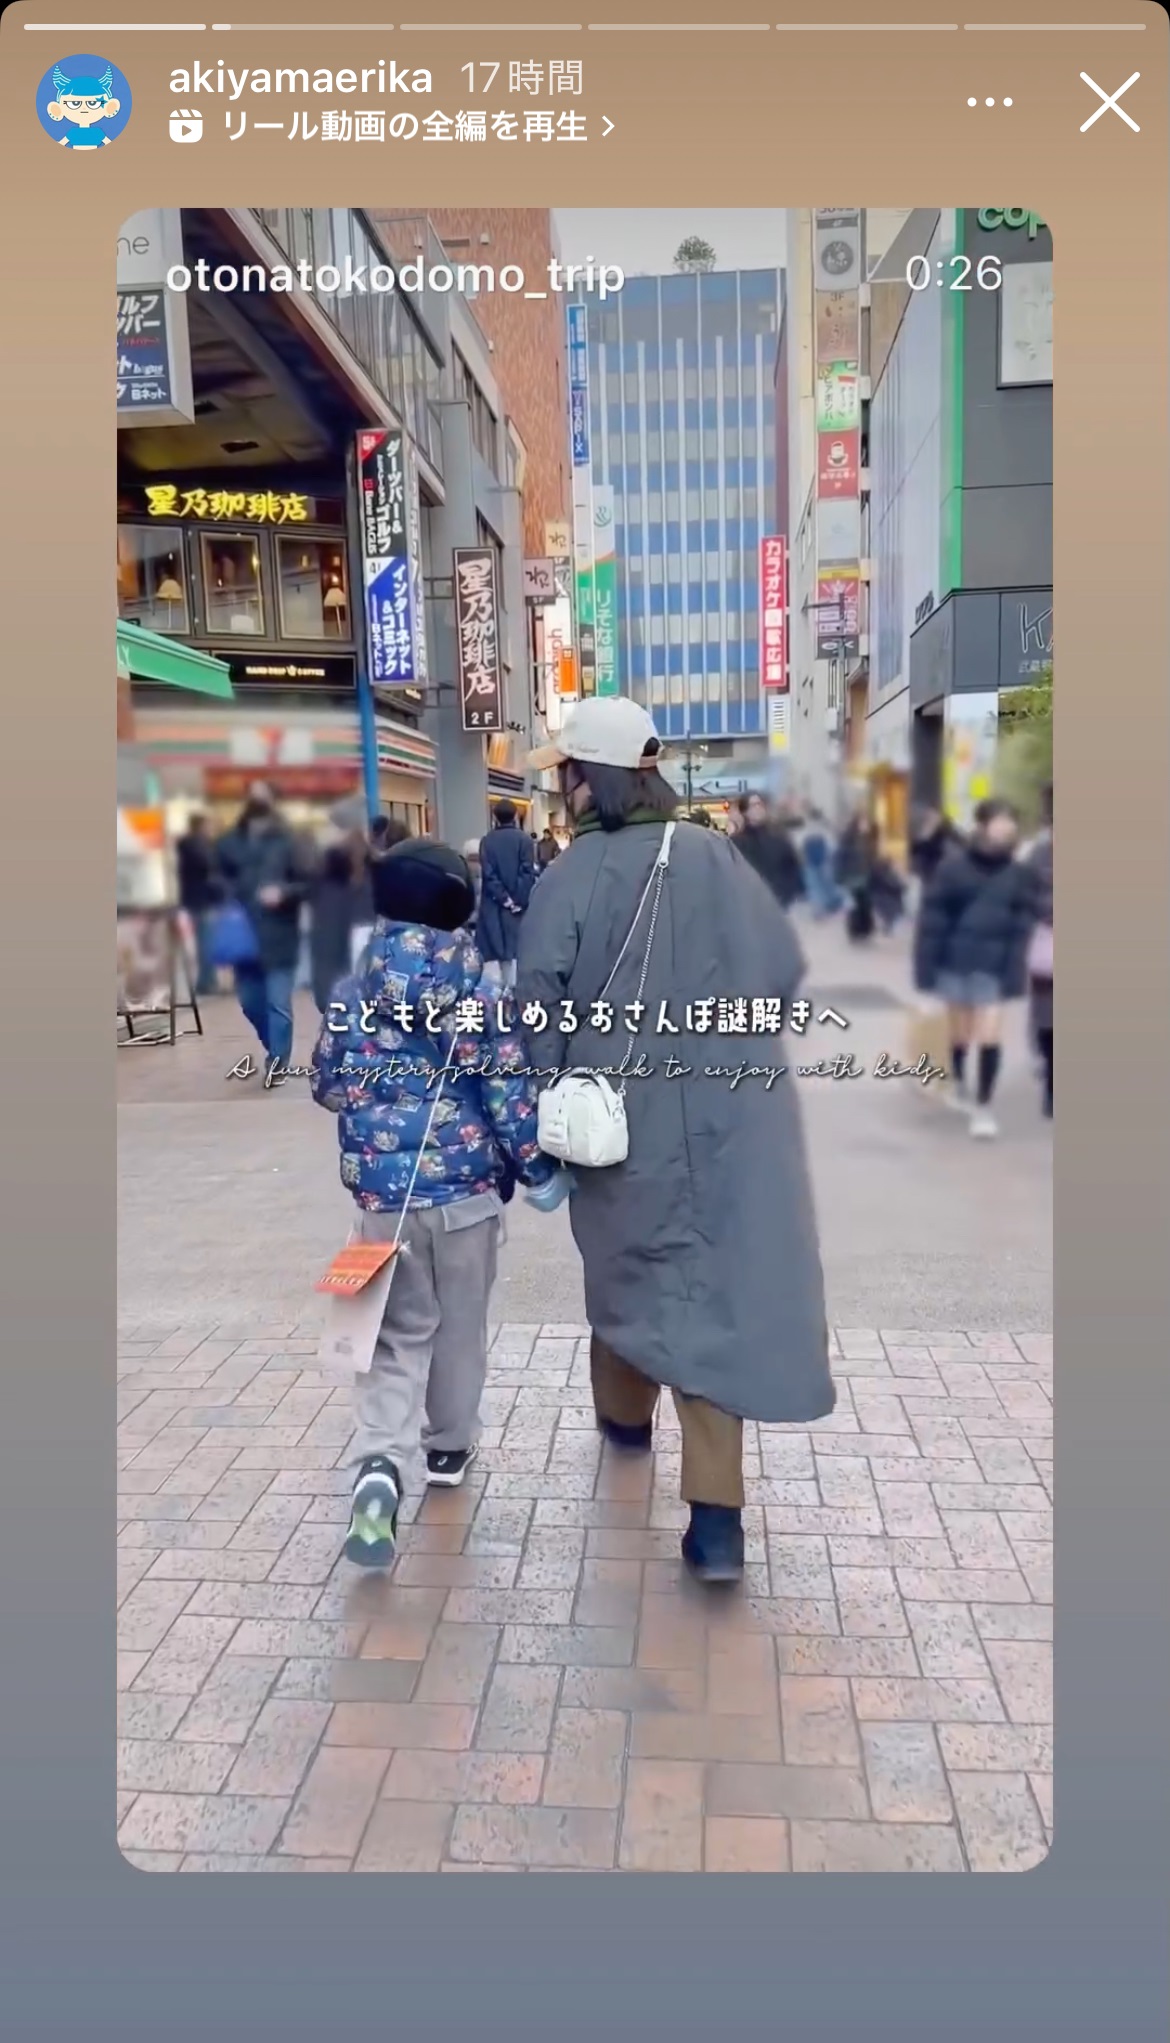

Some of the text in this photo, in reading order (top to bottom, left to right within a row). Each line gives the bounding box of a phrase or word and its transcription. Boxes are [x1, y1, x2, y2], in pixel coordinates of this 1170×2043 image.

[145, 484, 309, 525] 星乃珈琲店
[393, 564, 412, 676] インターネット
[458, 558, 496, 702] 星乃珈琲店
